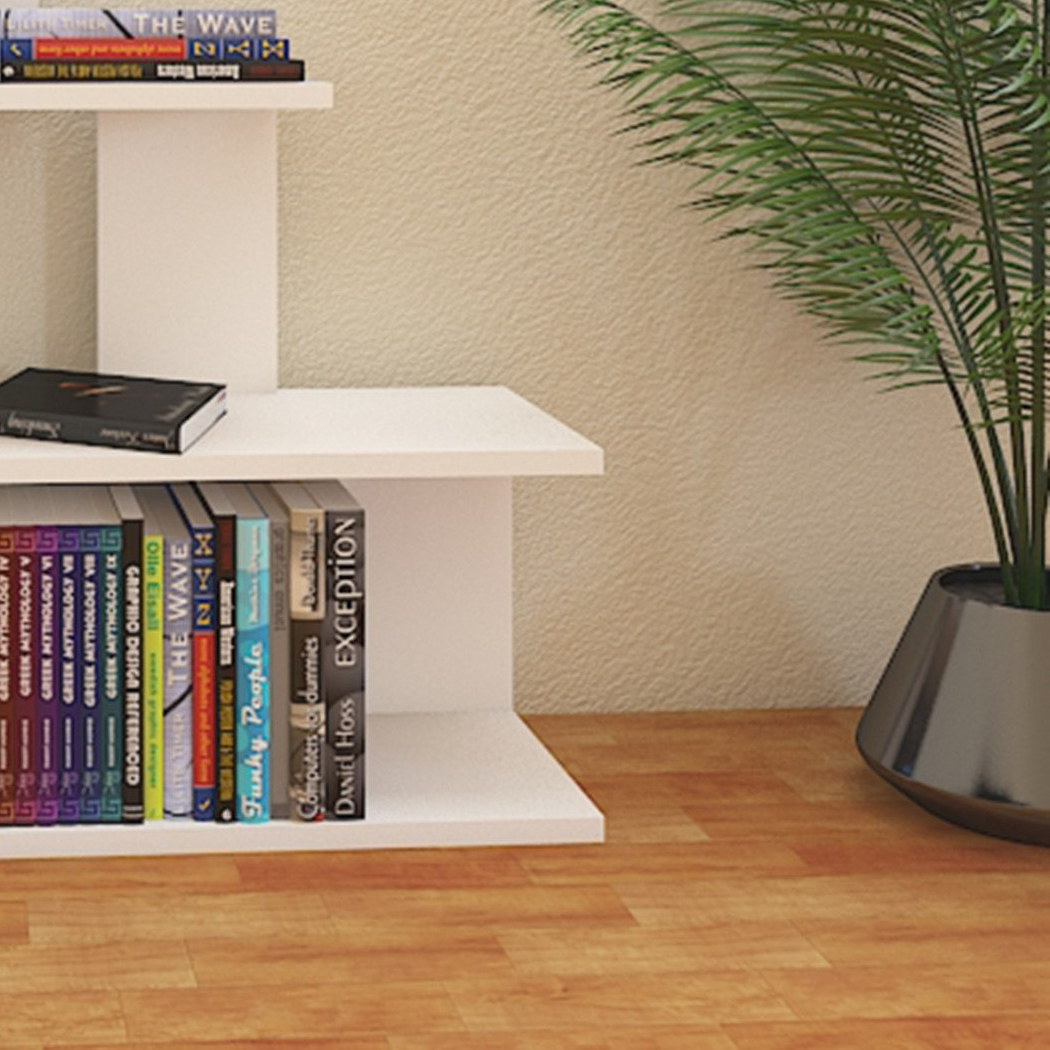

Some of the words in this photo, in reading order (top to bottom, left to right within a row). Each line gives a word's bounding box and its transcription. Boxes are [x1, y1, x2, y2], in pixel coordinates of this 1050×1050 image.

[133, 12, 185, 35] THE
[197, 13, 273, 35] WAVE
[19, 570, 31, 651] MYTHOLOGY
[41, 574, 53, 655] MYTHOLOGY
[63, 577, 74, 659] MYTHOLOGY
[106, 573, 117, 654] MYTHOLOGY
[125, 565, 140, 634] GRAPHIC
[166, 544, 189, 622] WAVE
[84, 582, 96, 662] MYTHOLOGY
[19, 655, 31, 696] GREEK
[41, 659, 53, 700] GREEK
[63, 663, 74, 704] GREEK
[84, 665, 96, 707] GREEK
[106, 657, 117, 699] GREEK
[125, 636, 140, 689] DESIGN
[166, 631, 189, 687] THE
[241, 642, 267, 726] People
[295, 636, 319, 704] dummies
[125, 691, 140, 786] REFERENCED
[240, 735, 269, 820] Funky
[295, 735, 319, 820] Computers
